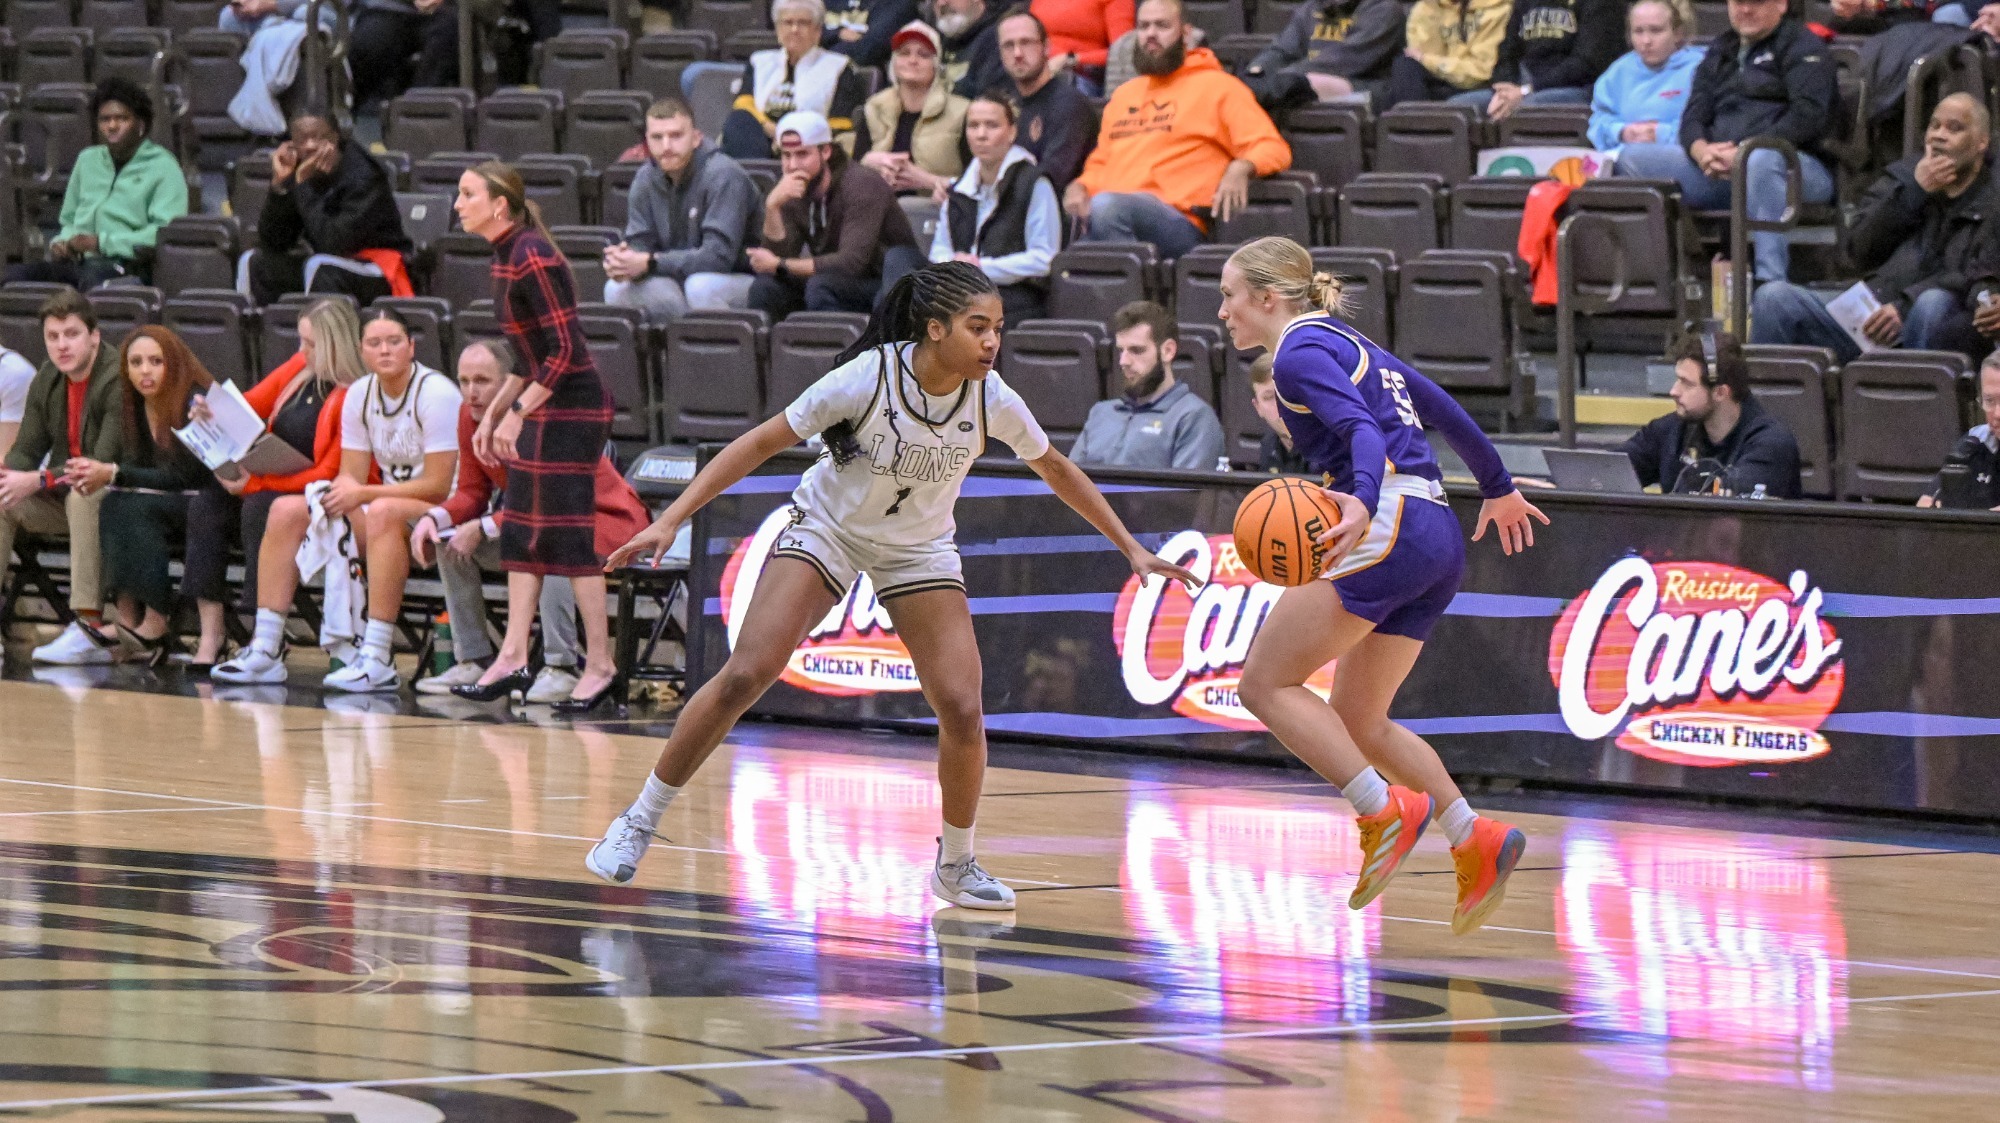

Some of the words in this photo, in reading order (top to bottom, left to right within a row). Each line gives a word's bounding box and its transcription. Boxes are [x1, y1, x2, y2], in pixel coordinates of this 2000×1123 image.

[870, 434, 970, 482] LIONS
[884, 486, 914, 518] 1
[1304, 515, 1329, 580] Wilso
[1661, 569, 1760, 611] Raising
[1559, 557, 1843, 740] Cane's
[803, 654, 864, 676] CHICKEN
[871, 659, 919, 681] FINGE
[1205, 686, 1240, 707] CHIC
[1650, 720, 1725, 746] CHICKEN
[1733, 725, 1808, 751] FINGERS
